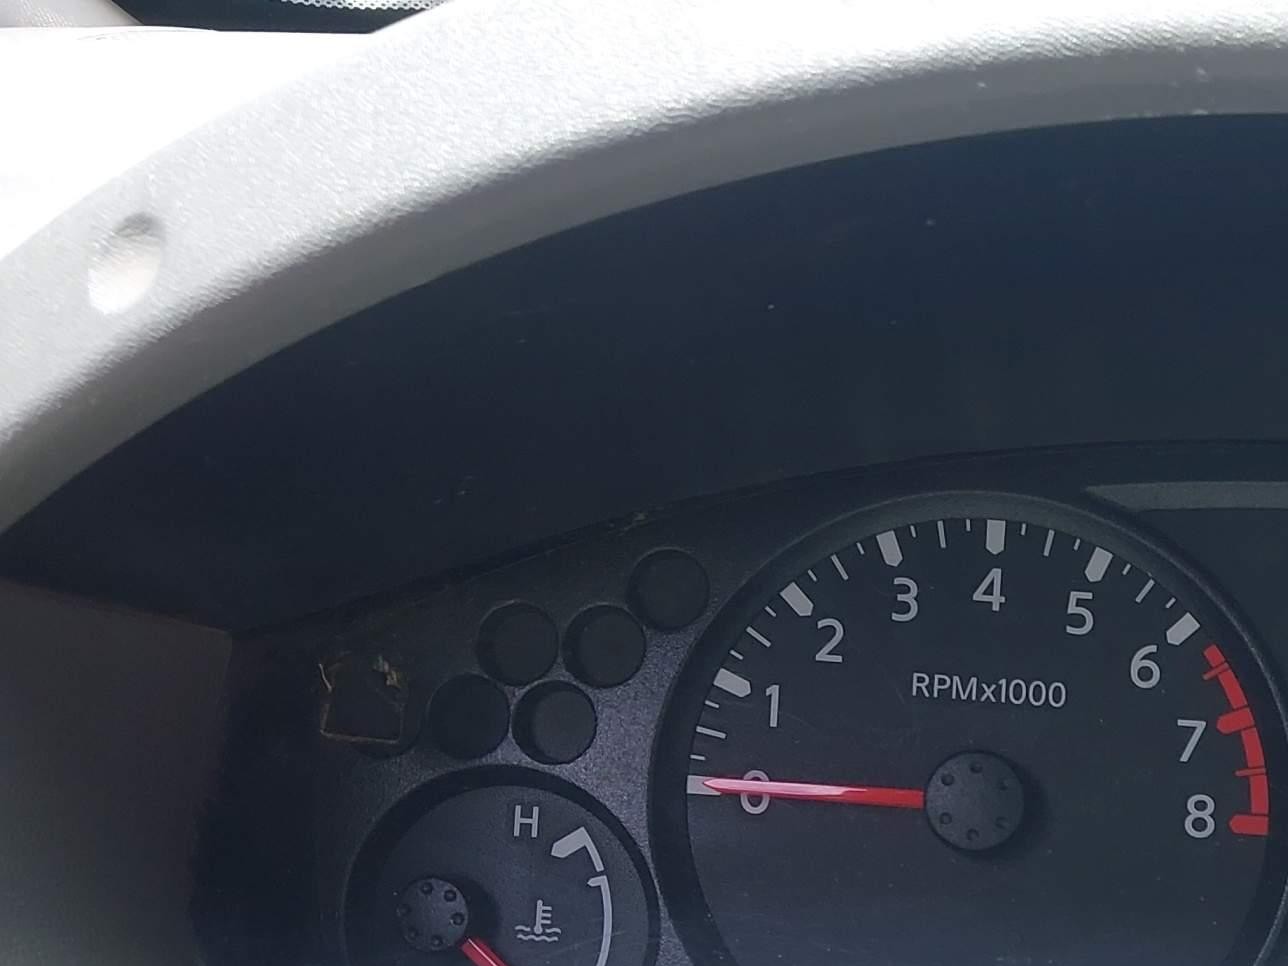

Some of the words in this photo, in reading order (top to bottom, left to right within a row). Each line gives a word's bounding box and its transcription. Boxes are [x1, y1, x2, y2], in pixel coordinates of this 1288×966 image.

[891, 577, 919, 622] 3
[973, 568, 1005, 611] 4
[1066, 591, 1094, 635] 5
[815, 619, 844, 662] 2
[1131, 644, 1161, 689] 6
[765, 685, 779, 727] 1
[911, 672, 1067, 708] RPMx1000
[1177, 719, 1207, 762] 7
[740, 770, 770, 815] 0
[514, 805, 539, 838] H
[1185, 794, 1216, 838] 8
